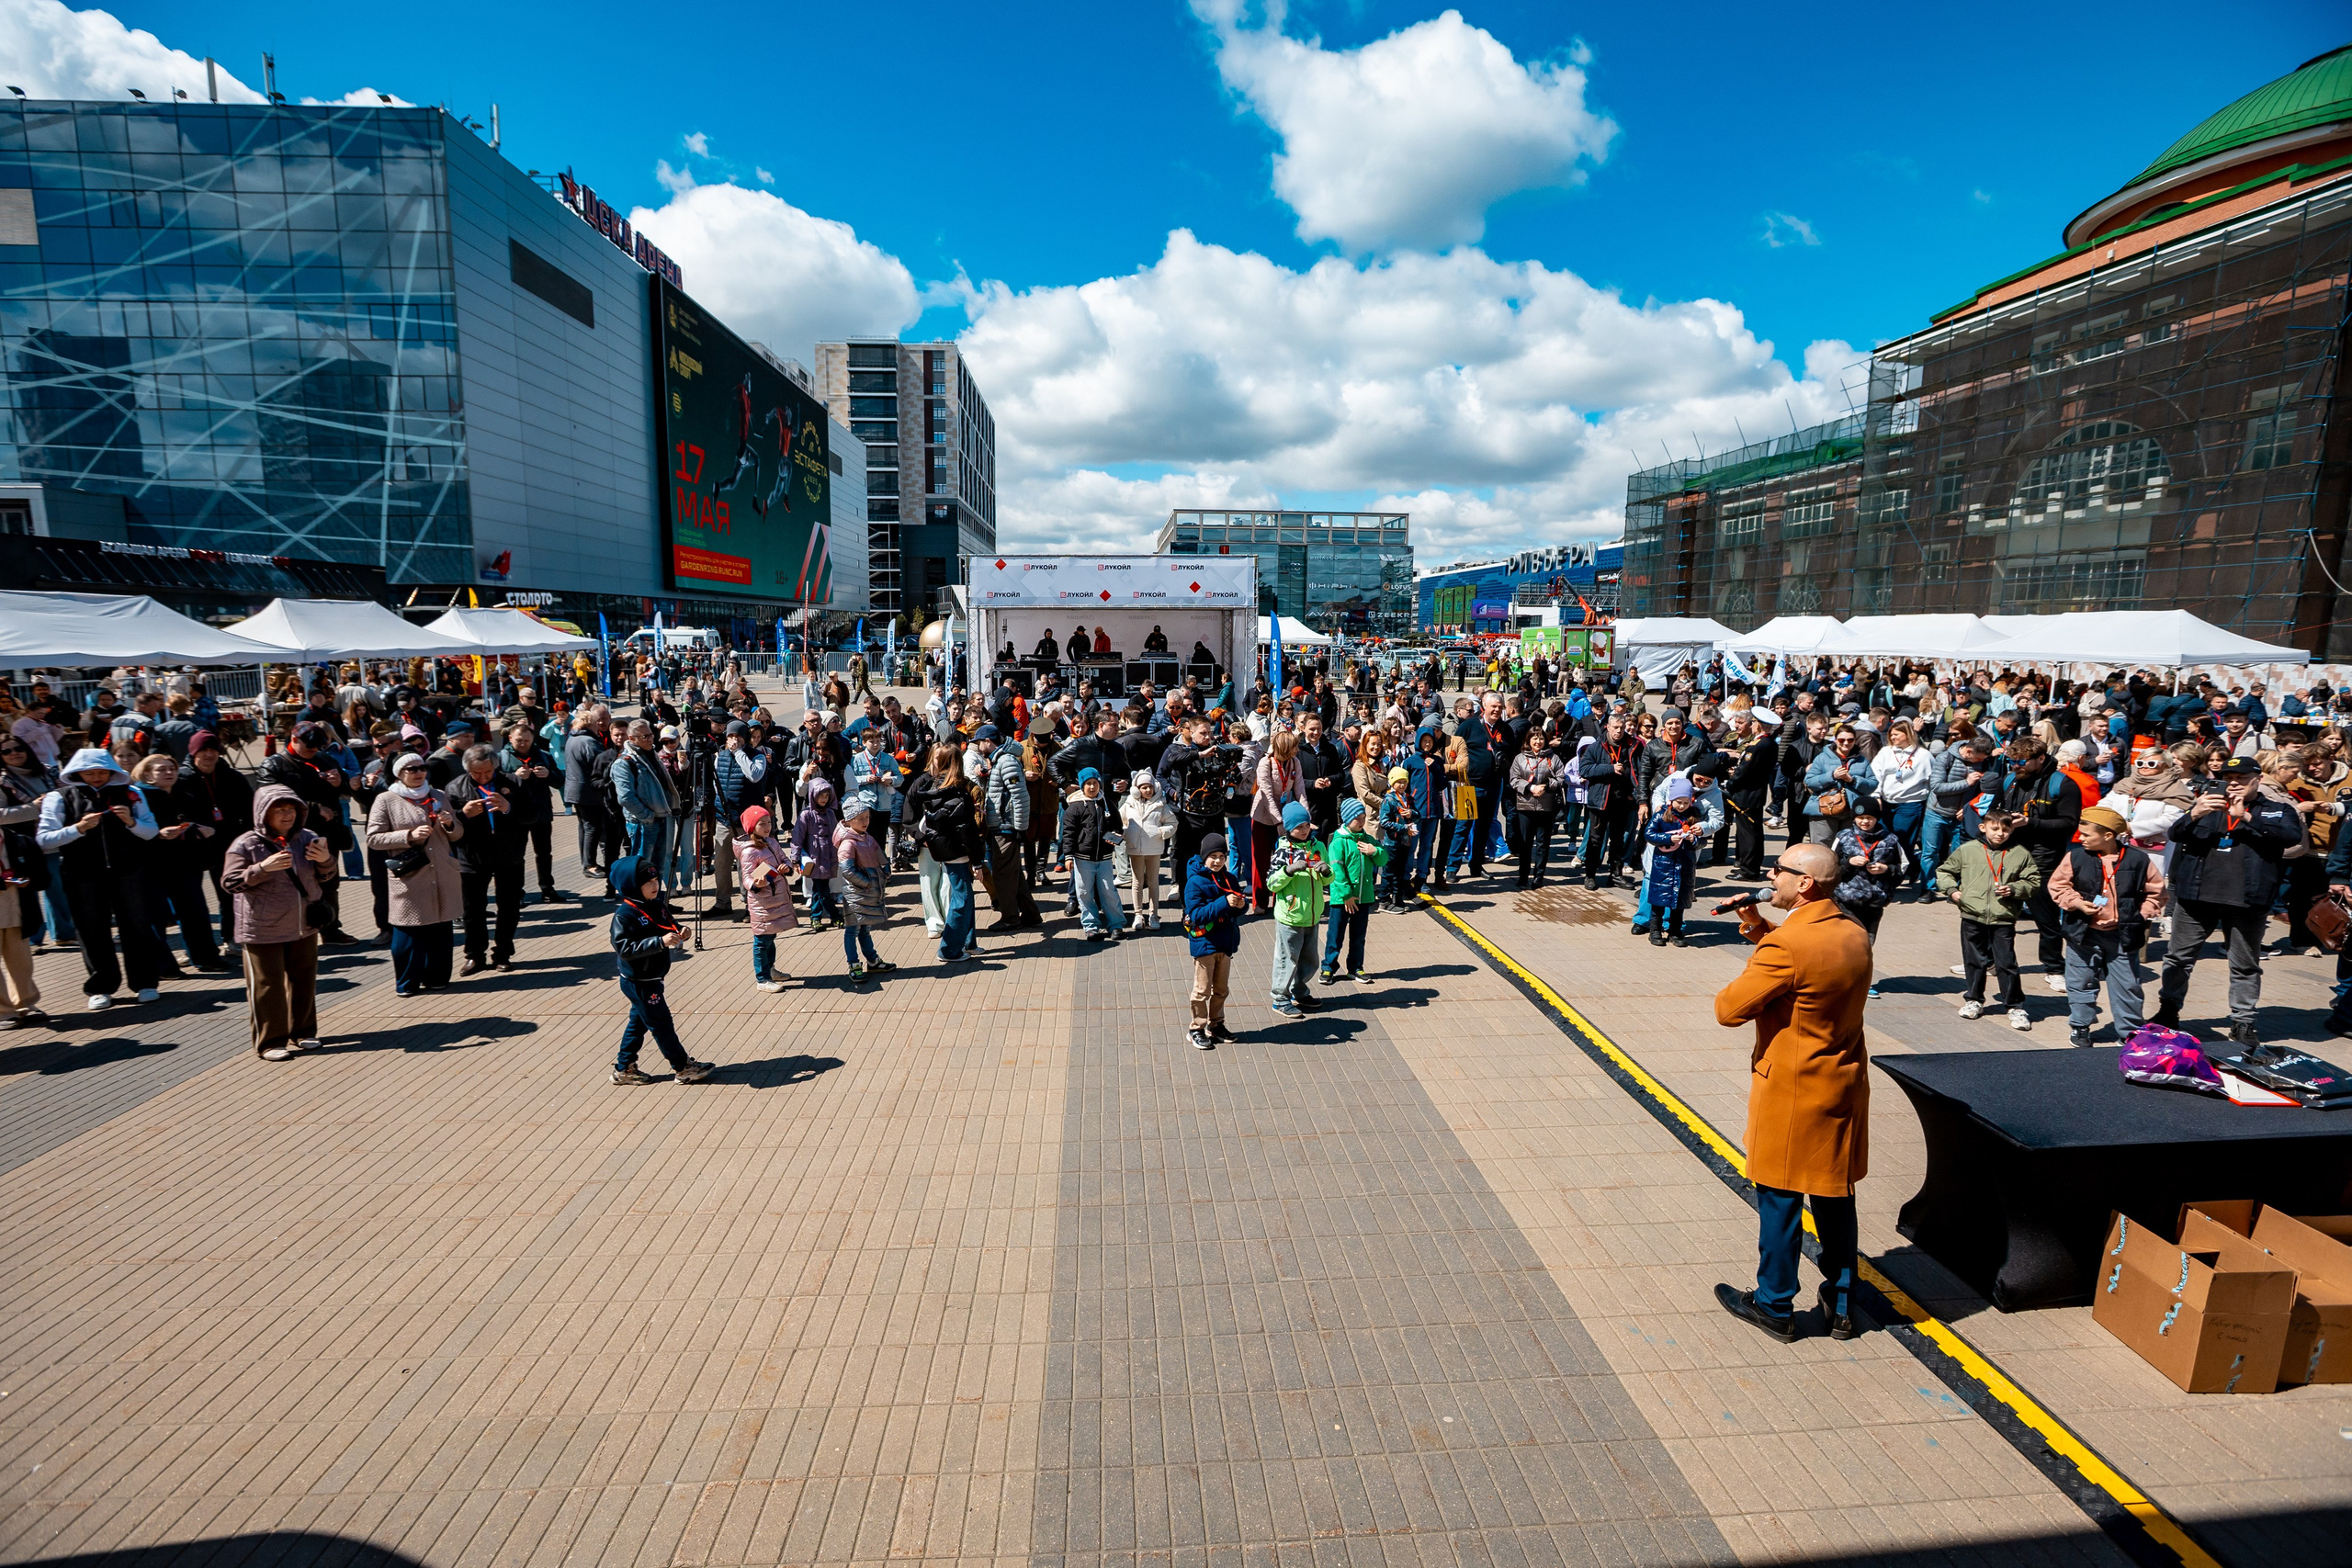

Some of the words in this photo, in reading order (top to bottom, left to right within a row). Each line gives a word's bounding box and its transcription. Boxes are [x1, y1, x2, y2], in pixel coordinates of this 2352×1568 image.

[582, 185, 634, 258] ЦСКА
[636, 231, 684, 291] АРЕНА
[675, 440, 705, 485] 17
[794, 449, 828, 479] ЭСТАФЕТА
[676, 486, 730, 536] МАЯ
[157, 547, 191, 558] АРЕНА
[1508, 541, 1598, 576] РИВЬЕРА
[639, 916, 649, 926] 15
